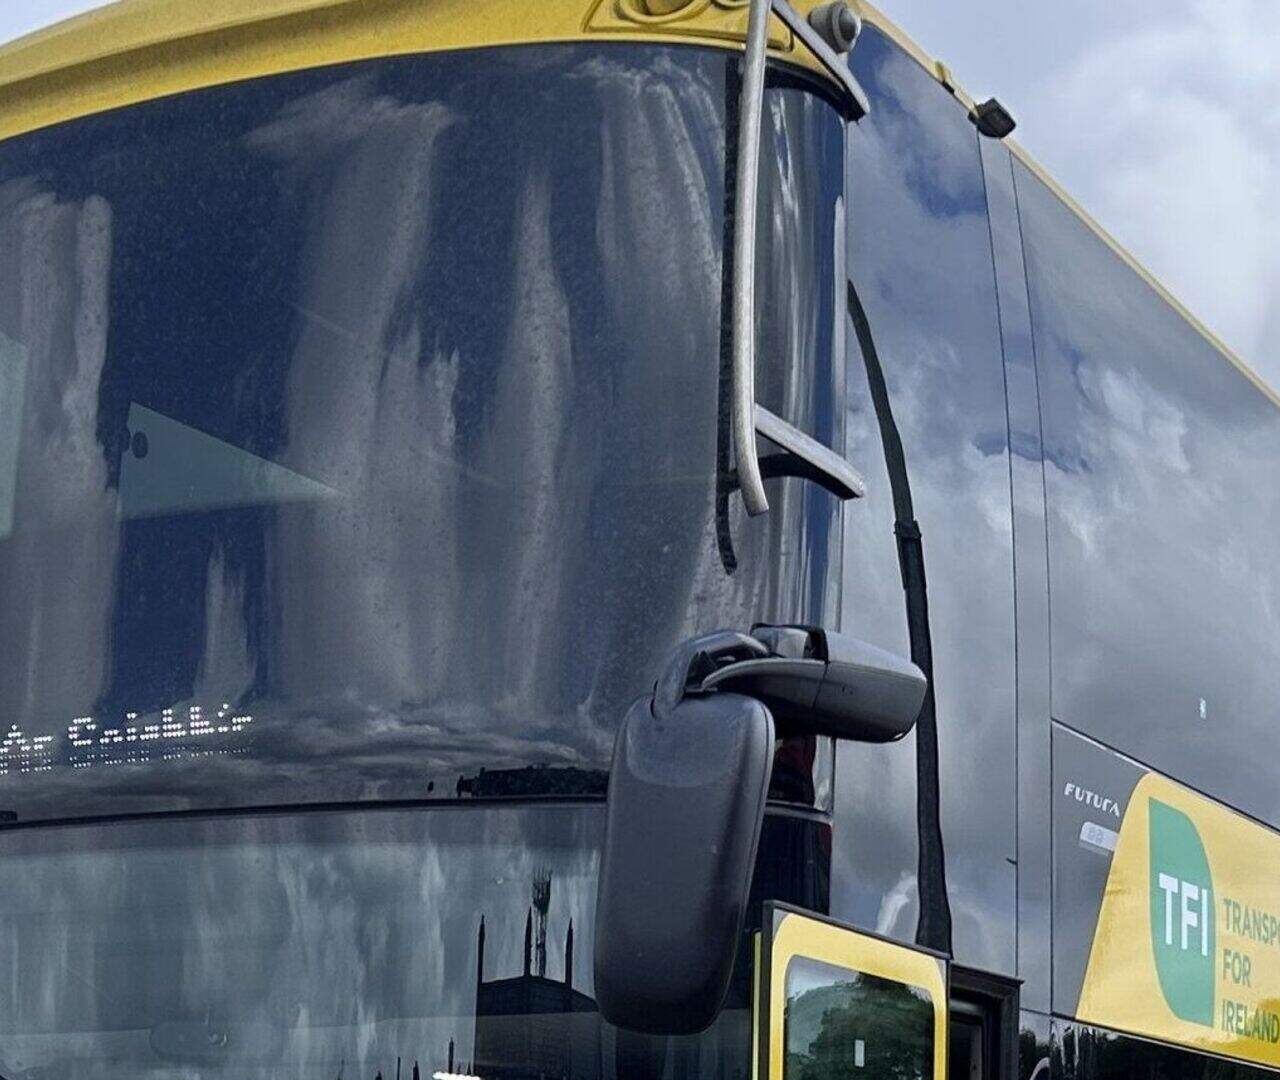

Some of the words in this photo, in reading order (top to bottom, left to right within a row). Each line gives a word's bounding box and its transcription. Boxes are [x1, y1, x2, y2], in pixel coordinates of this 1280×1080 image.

[1064, 782, 1120, 817] FUTURA
[1158, 872, 1209, 956] TFI
[1222, 949, 1252, 987] FOR
[1221, 1001, 1280, 1044] IRELAND
